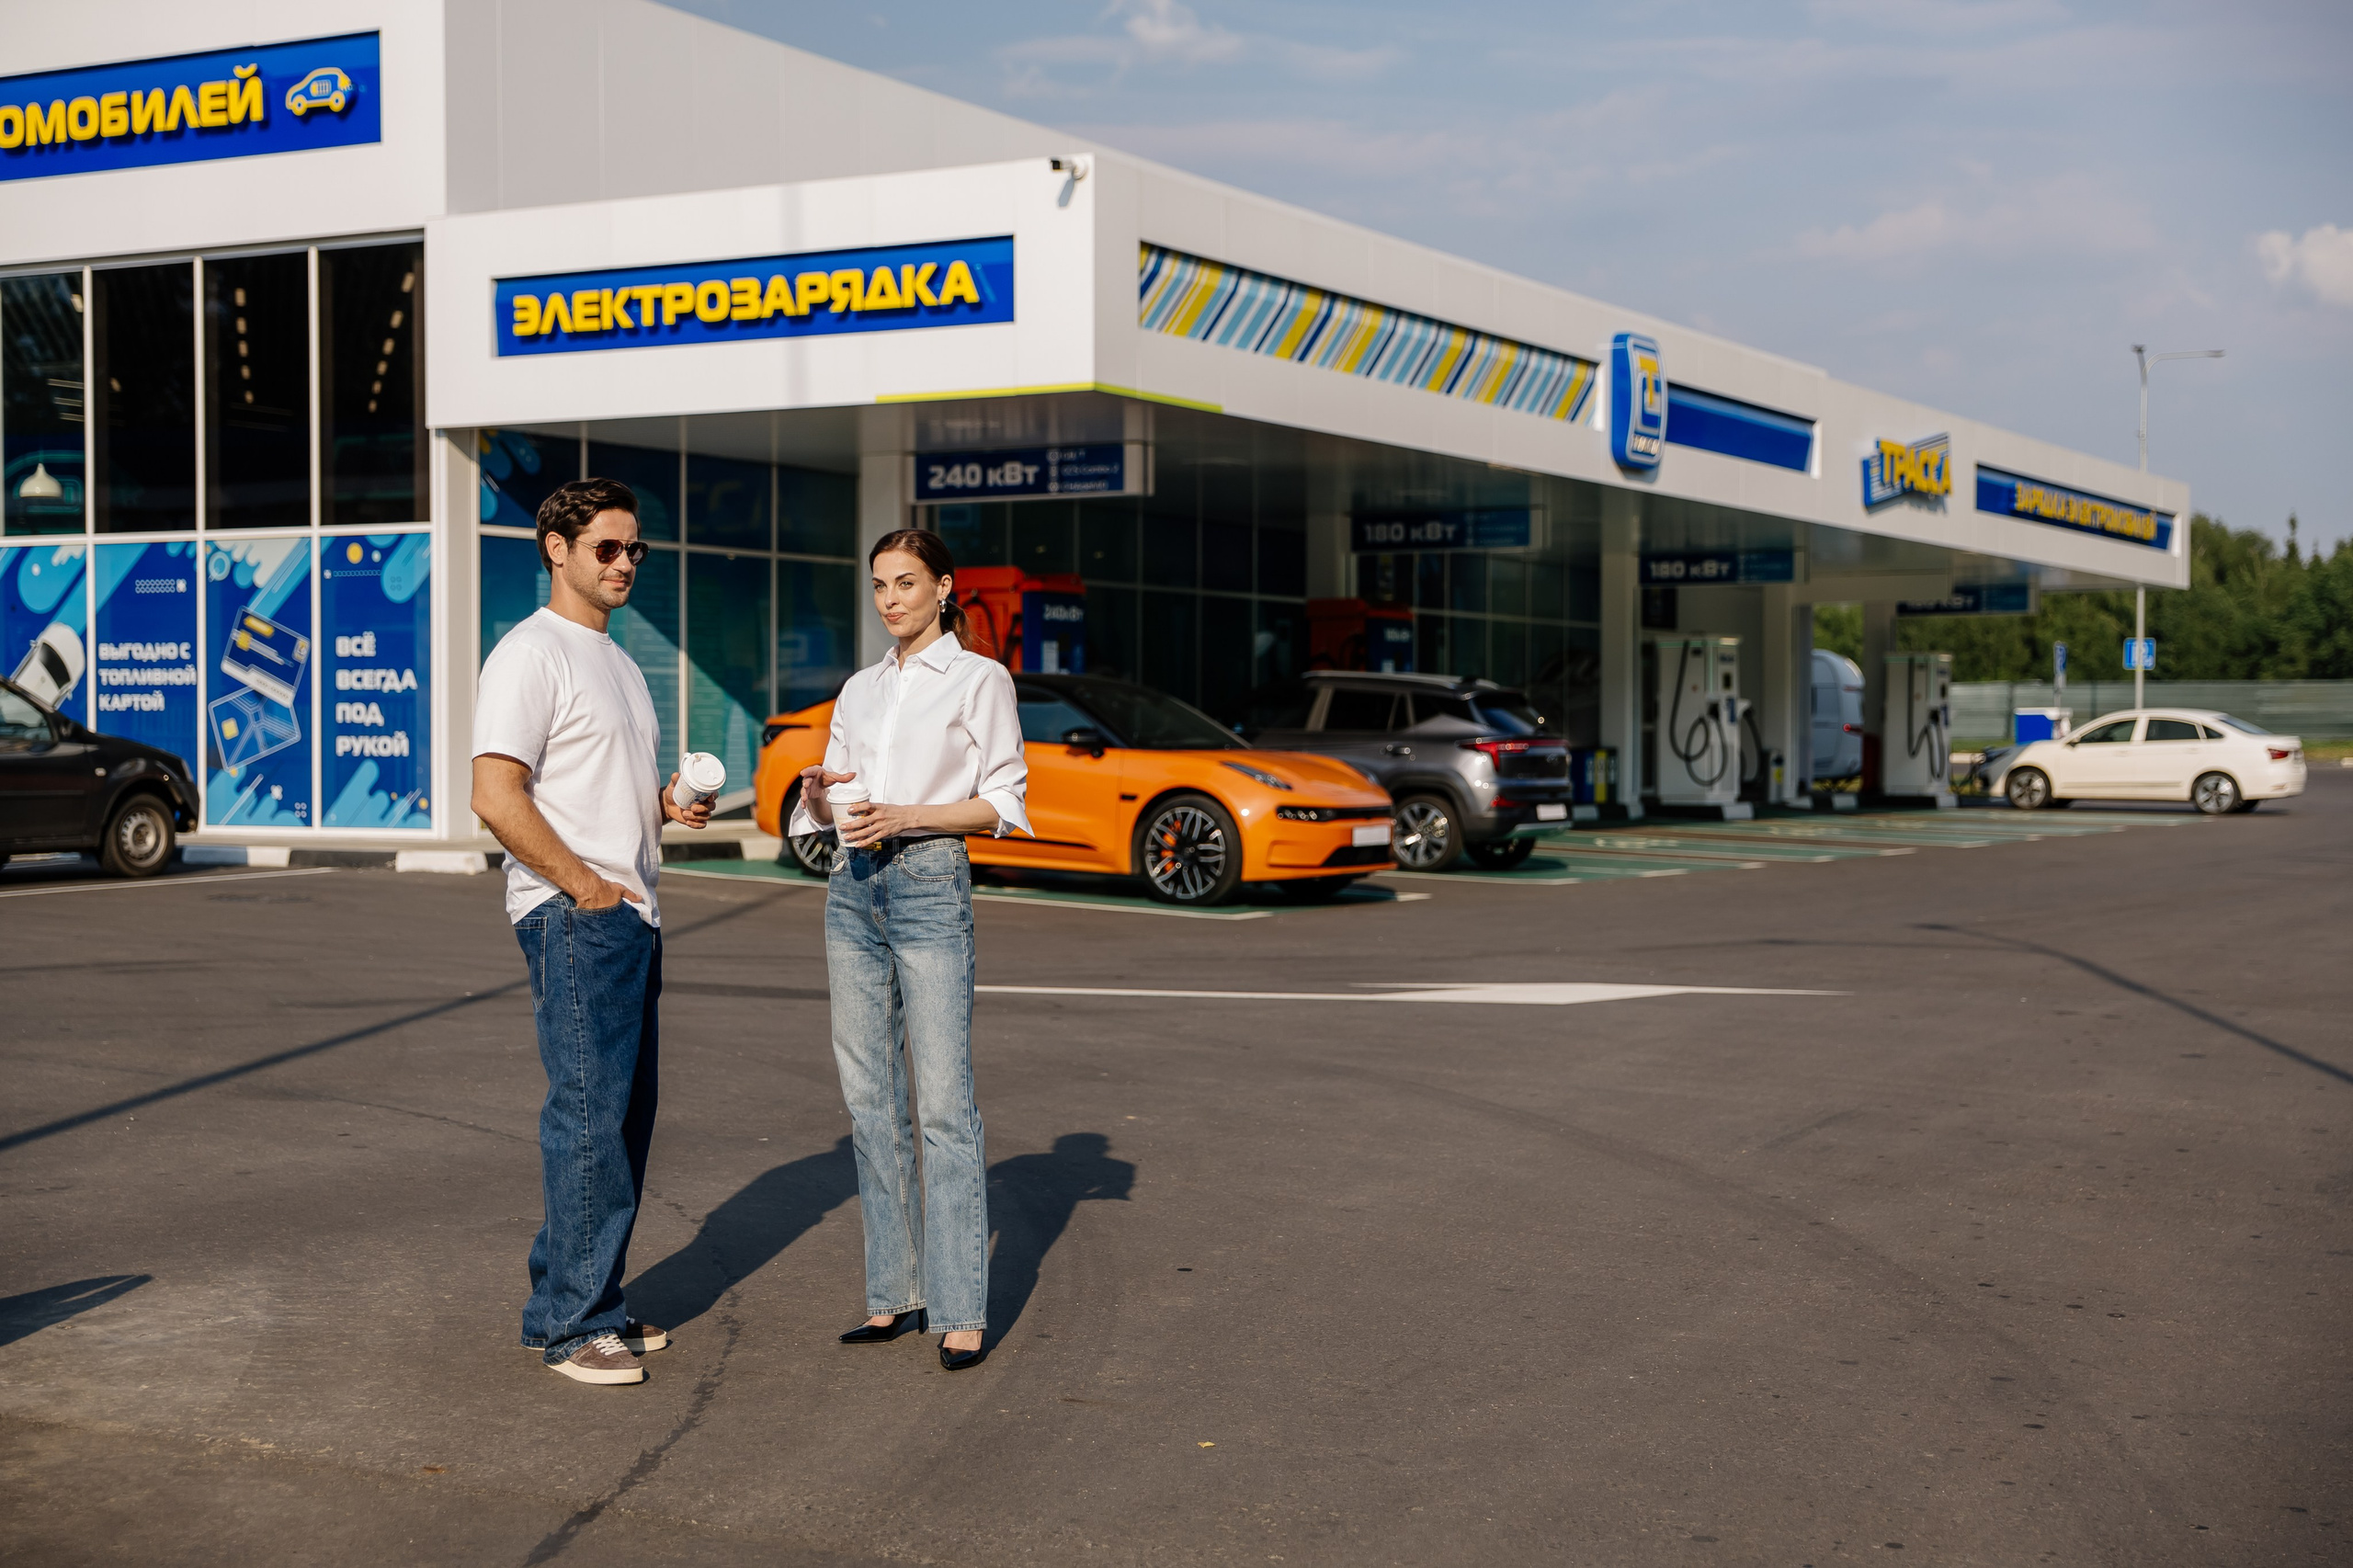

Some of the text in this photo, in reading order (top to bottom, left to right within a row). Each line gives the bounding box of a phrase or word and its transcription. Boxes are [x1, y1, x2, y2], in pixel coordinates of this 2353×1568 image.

[513, 259, 981, 336] ЭЛЕКТРОЗАРЯДКА
[928, 463, 983, 490] 240
[98, 642, 178, 662] ВЫГОДНО
[335, 631, 377, 657] ВСЁ
[97, 664, 197, 686] ТОПЛИВНОЙ
[335, 668, 417, 693] ВСЕГДА
[98, 690, 165, 711] КАРТОЙ
[335, 702, 384, 726] ПОД
[335, 731, 409, 756] РУКОЙ
